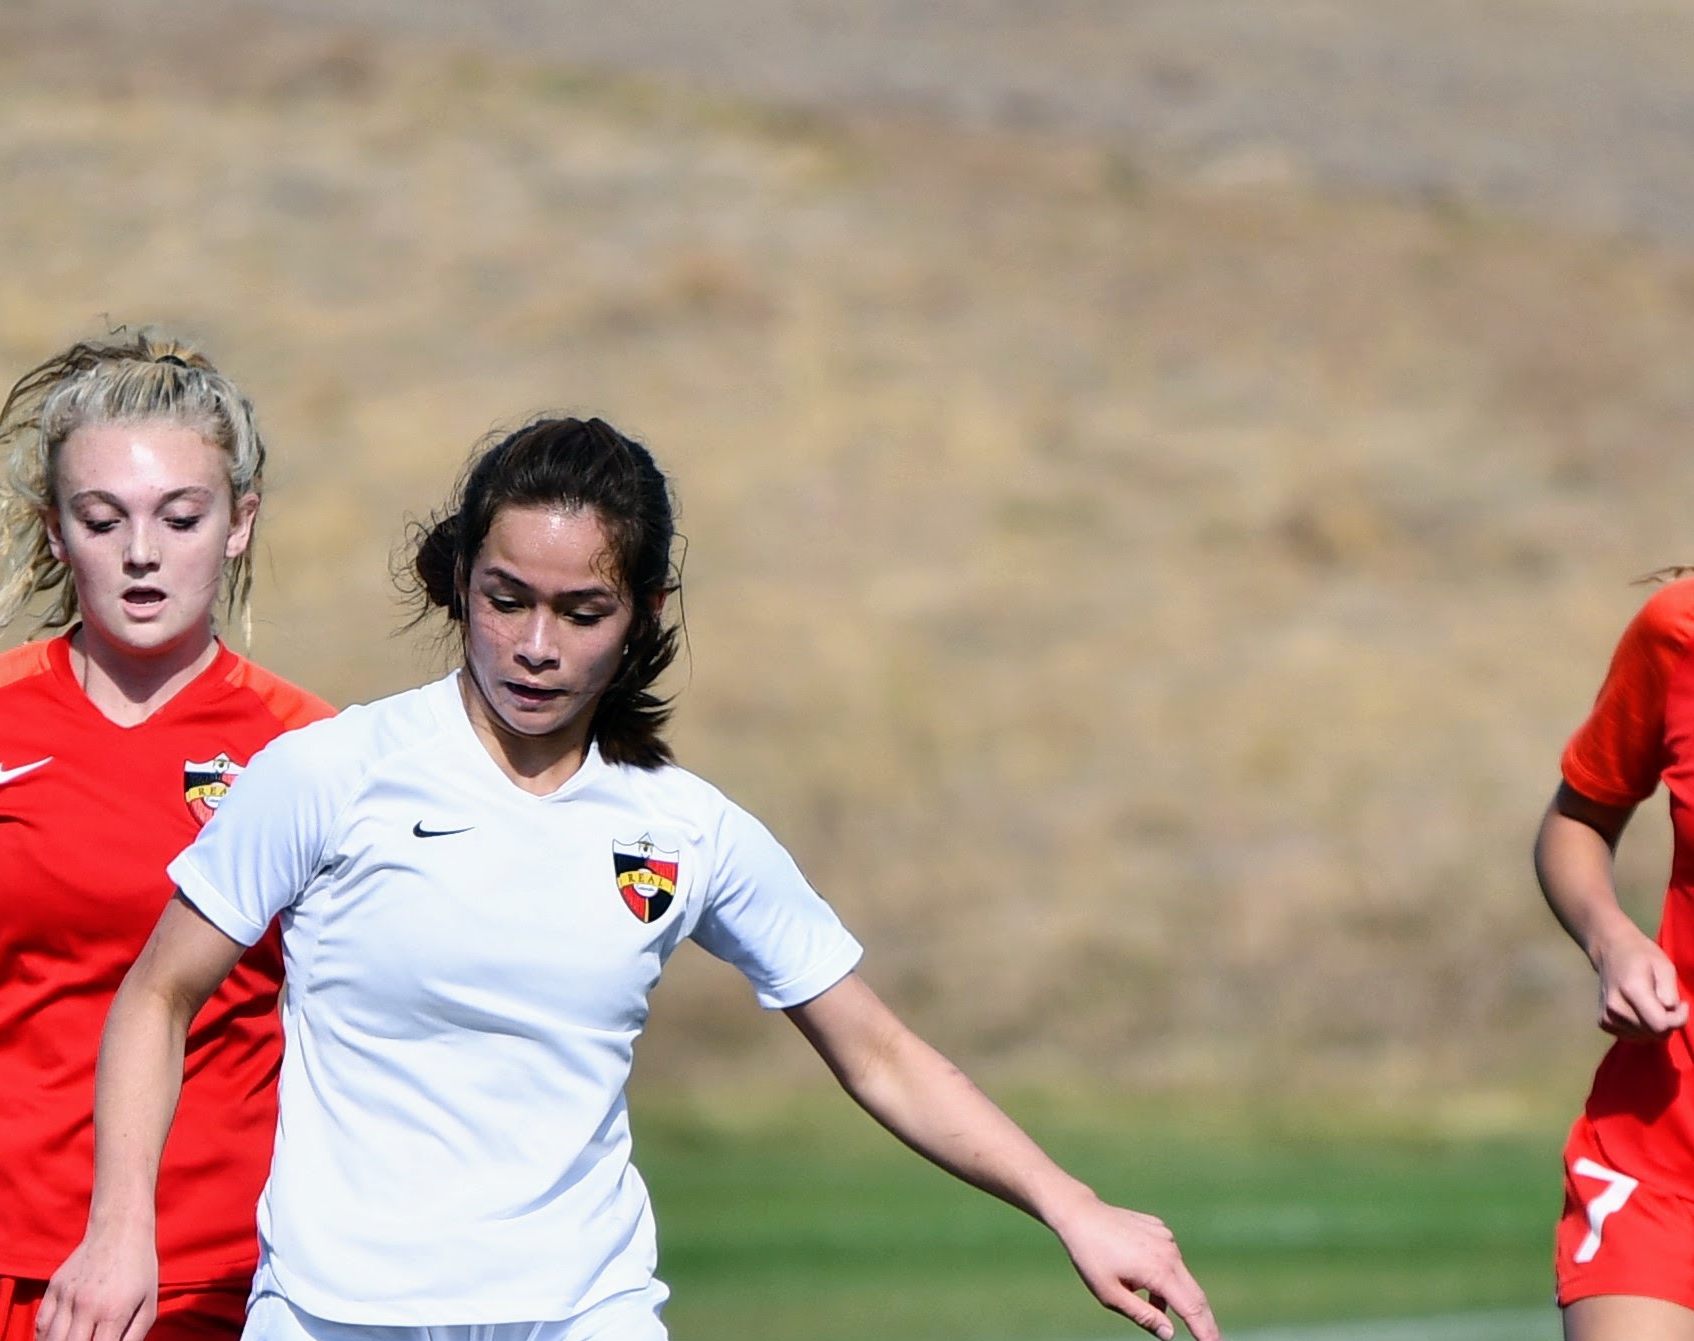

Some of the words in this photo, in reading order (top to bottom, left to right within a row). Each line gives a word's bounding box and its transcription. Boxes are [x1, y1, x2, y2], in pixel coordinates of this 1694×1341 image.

[198, 786, 228, 796] REA
[627, 873, 664, 887] REAL
[1573, 1157, 1639, 1264] 7
